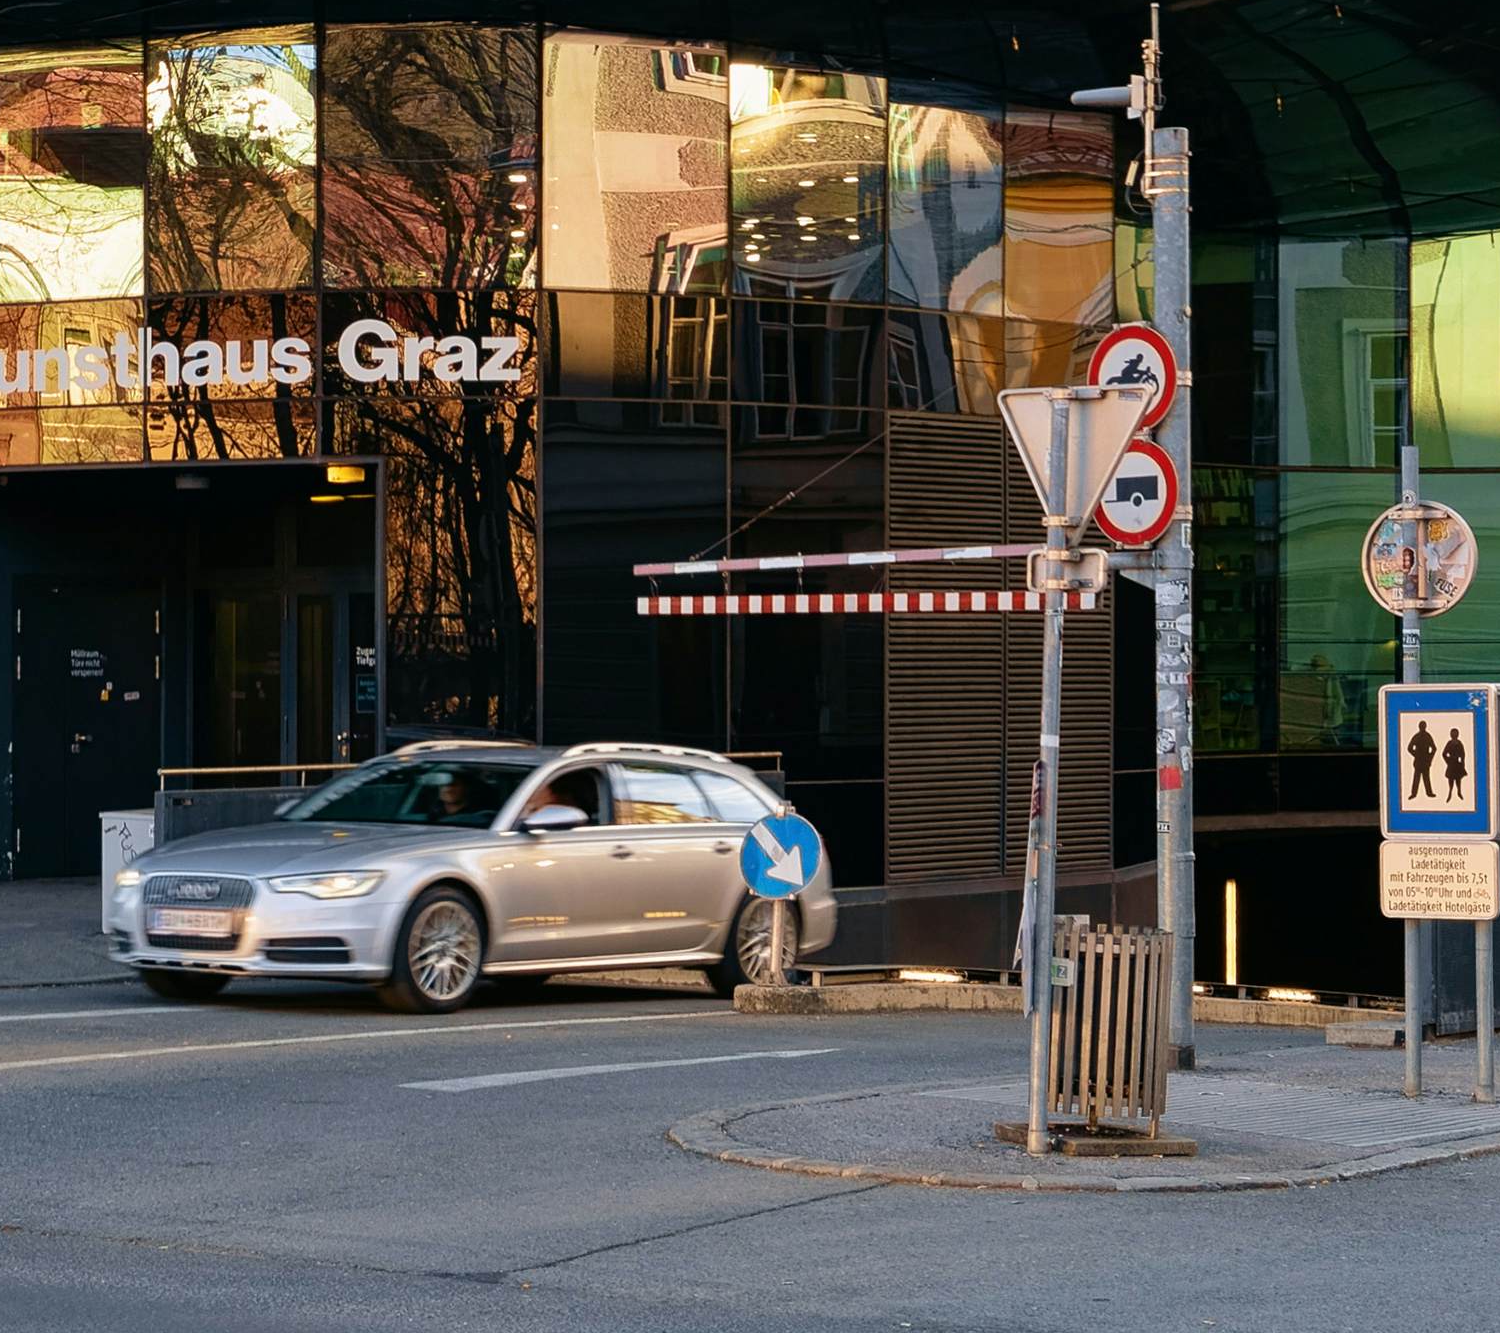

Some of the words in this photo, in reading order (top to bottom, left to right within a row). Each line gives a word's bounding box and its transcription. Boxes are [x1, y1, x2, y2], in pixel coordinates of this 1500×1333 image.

[338, 318, 522, 384] Graz
[1435, 578, 1458, 597] FUSE
[1408, 845, 1468, 857] ausgenommen
[1411, 858, 1466, 872] Ladetätigkeit
[1390, 871, 1404, 882] mit
[1406, 872, 1454, 885] Fahrzeugen
[1456, 872, 1469, 884] bis
[1388, 888, 1404, 897] von
[1439, 887, 1453, 898] Uhr
[1456, 887, 1472, 898] und
[1388, 900, 1443, 913] Ladetätigkeit
[1445, 901, 1491, 915] Hotelgäste
